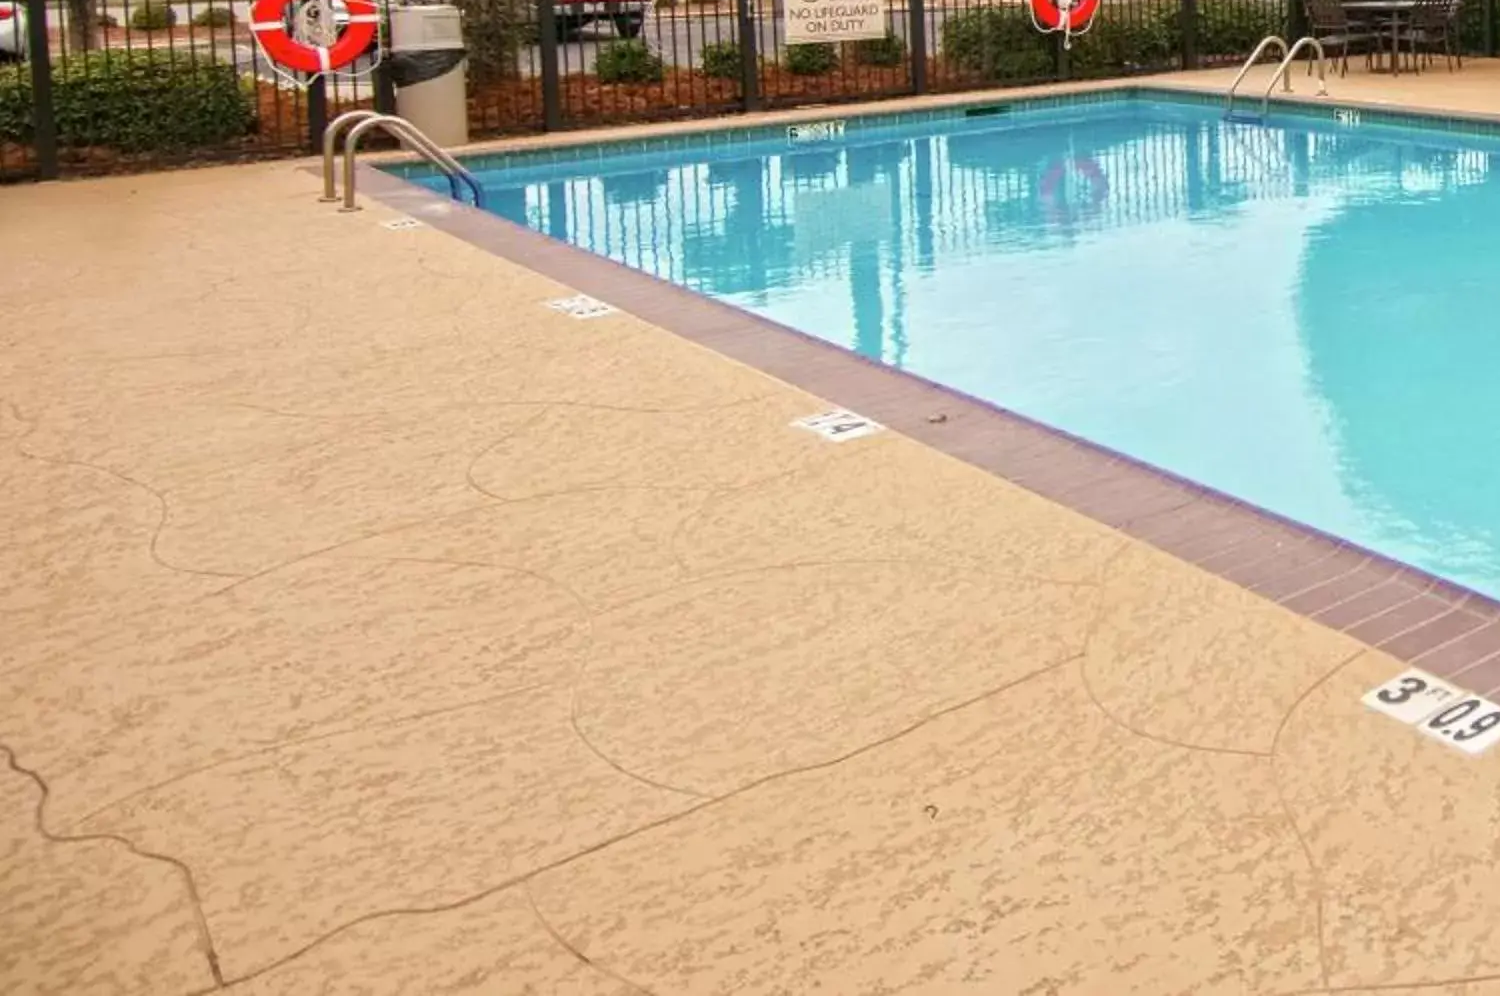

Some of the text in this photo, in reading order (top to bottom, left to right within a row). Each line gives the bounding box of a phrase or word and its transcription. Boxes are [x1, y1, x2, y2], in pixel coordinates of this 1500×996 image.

[790, 4, 879, 20] NO LIFEGUARD
[806, 19, 865, 33] ON DUTY
